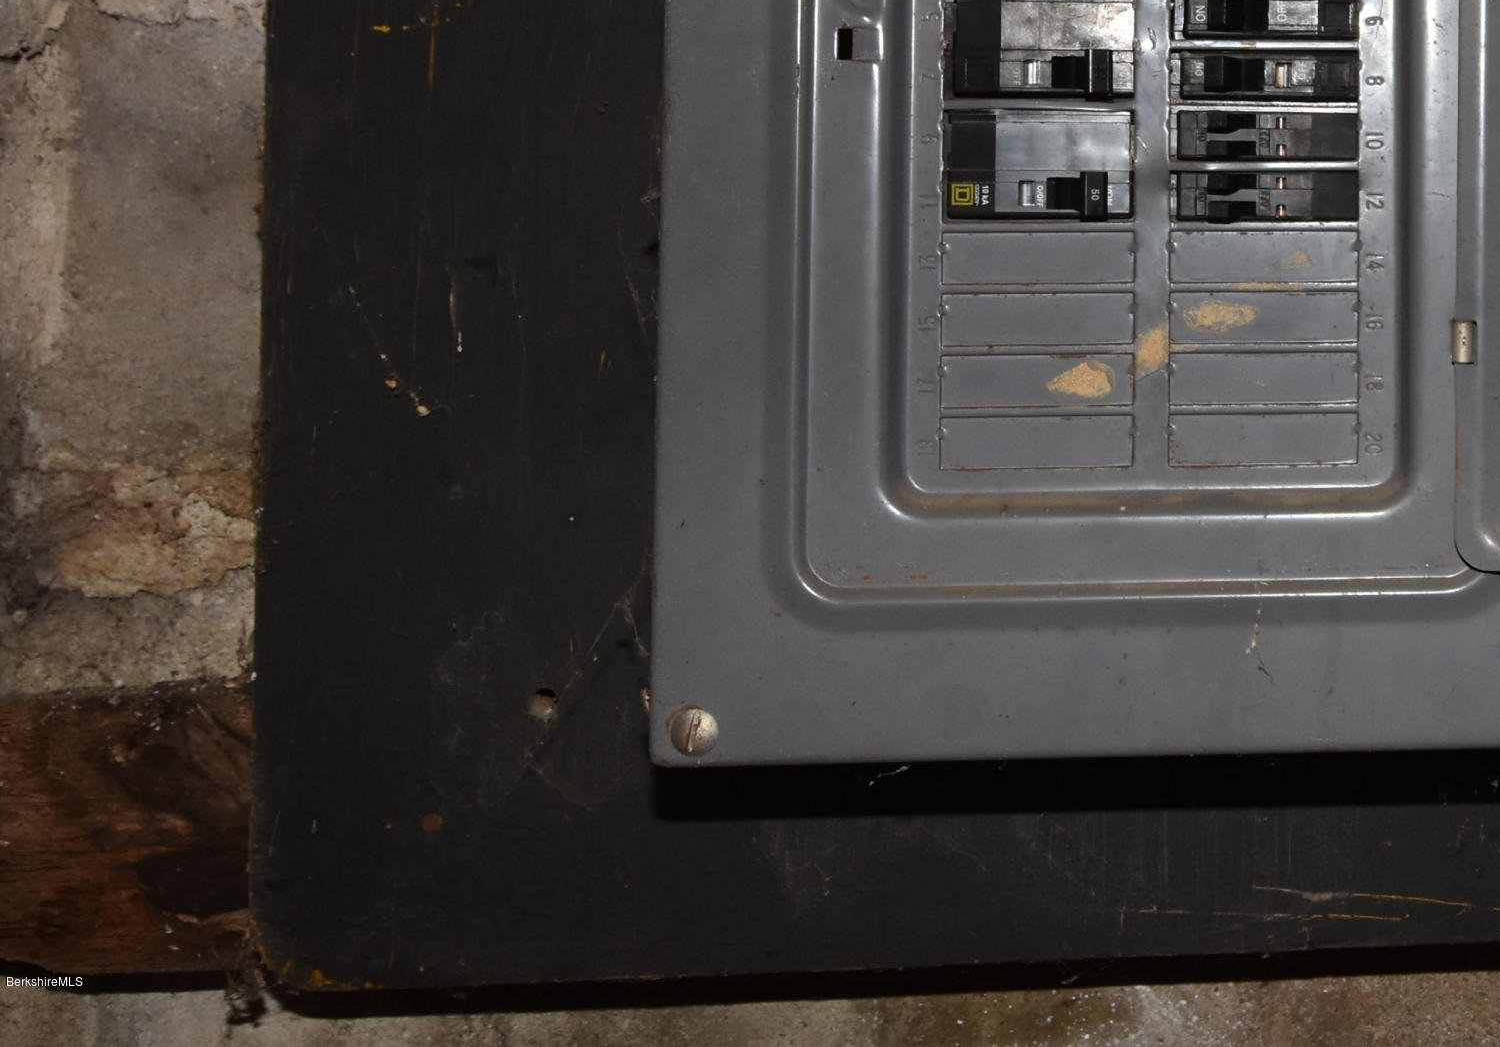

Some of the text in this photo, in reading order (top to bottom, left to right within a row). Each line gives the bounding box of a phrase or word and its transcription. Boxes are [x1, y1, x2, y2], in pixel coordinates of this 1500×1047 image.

[1195, 5, 1206, 22] ON
[1277, 0, 1287, 22] OFF
[1365, 15, 1385, 26] 6
[1365, 76, 1385, 86] 8
[1365, 131, 1385, 150] 10
[1091, 188, 1100, 201] 50
[1365, 192, 1385, 210] 12
[918, 255, 936, 271] 13
[1366, 253, 1385, 272] 14
[918, 315, 936, 332] 15
[1365, 314, 1384, 330] 16
[917, 378, 936, 395] 17
[1365, 375, 1384, 391] 18
[1365, 432, 1383, 454] 20
